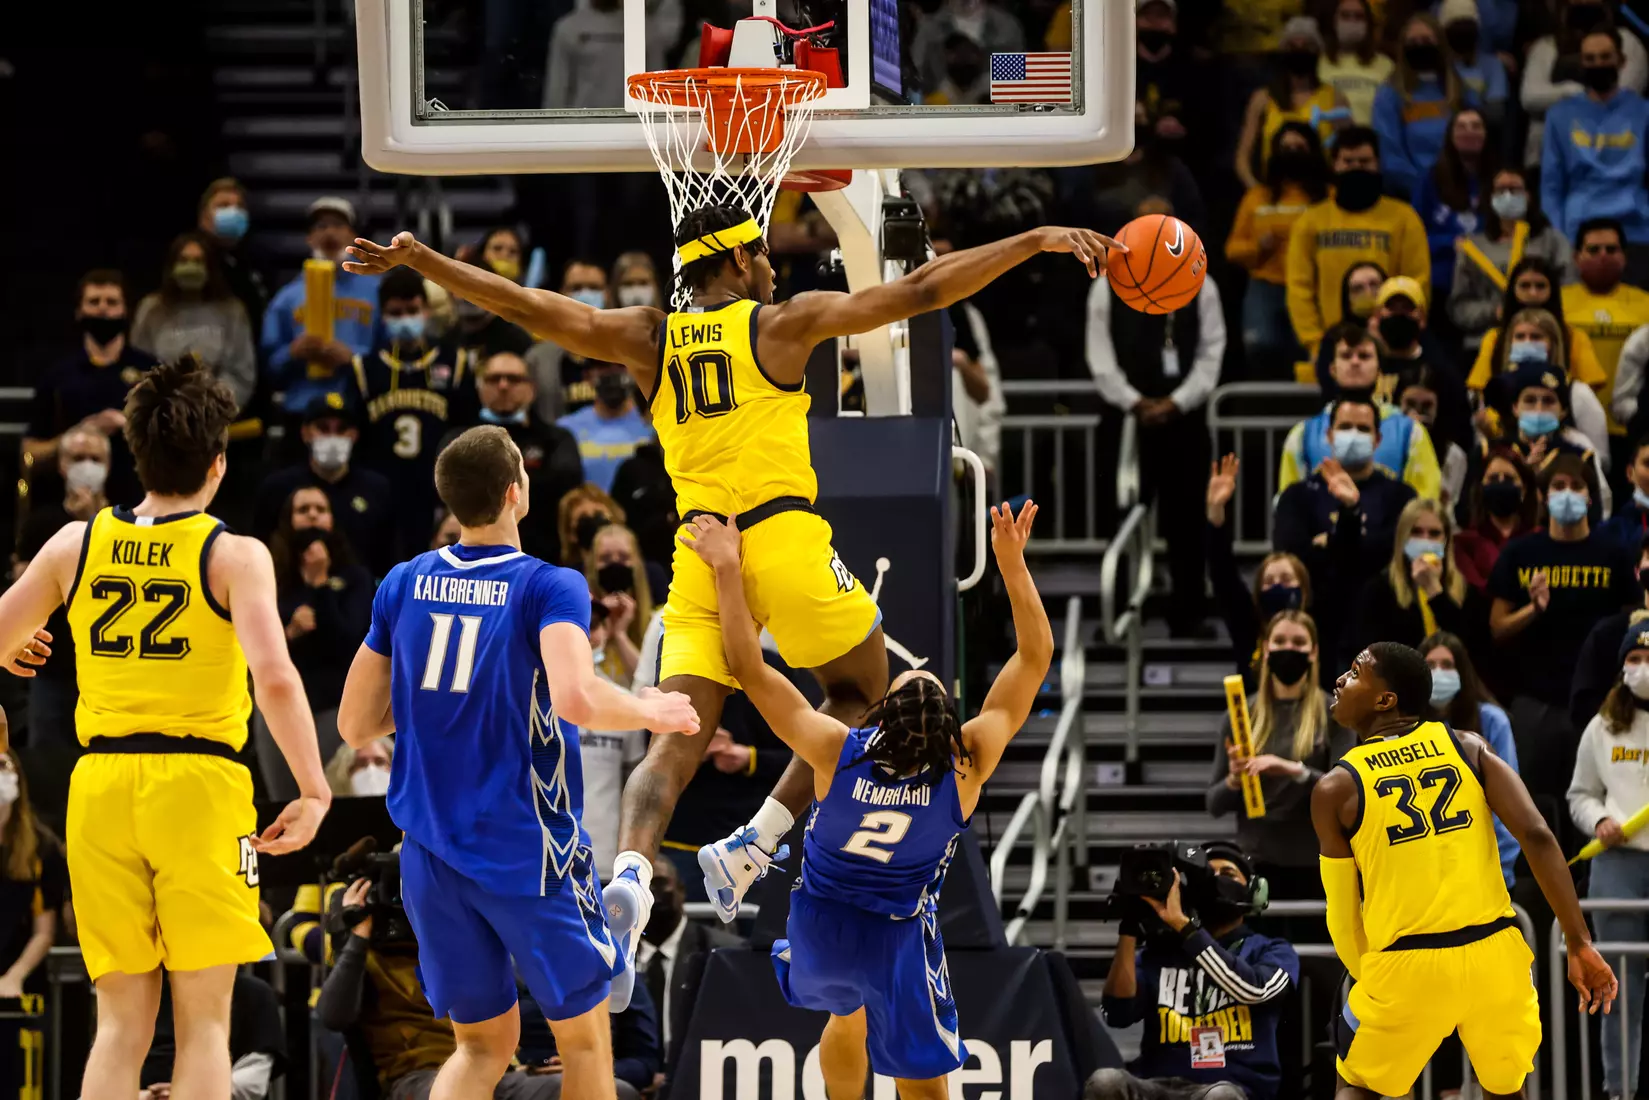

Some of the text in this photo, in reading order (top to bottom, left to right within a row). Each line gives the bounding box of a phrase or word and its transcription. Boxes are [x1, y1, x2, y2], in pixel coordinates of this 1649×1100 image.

[670, 323, 722, 349] LEWIS
[668, 349, 738, 424] 10
[392, 412, 422, 459] 3
[111, 539, 174, 567] KOLEK
[413, 574, 509, 607] KALKBRENNER
[90, 574, 191, 660] 22
[419, 612, 483, 694] 11
[1364, 740, 1445, 771] MORSELL
[852, 777, 931, 806] NEMBHARD
[1374, 763, 1473, 846] 32
[839, 809, 913, 864] 2
